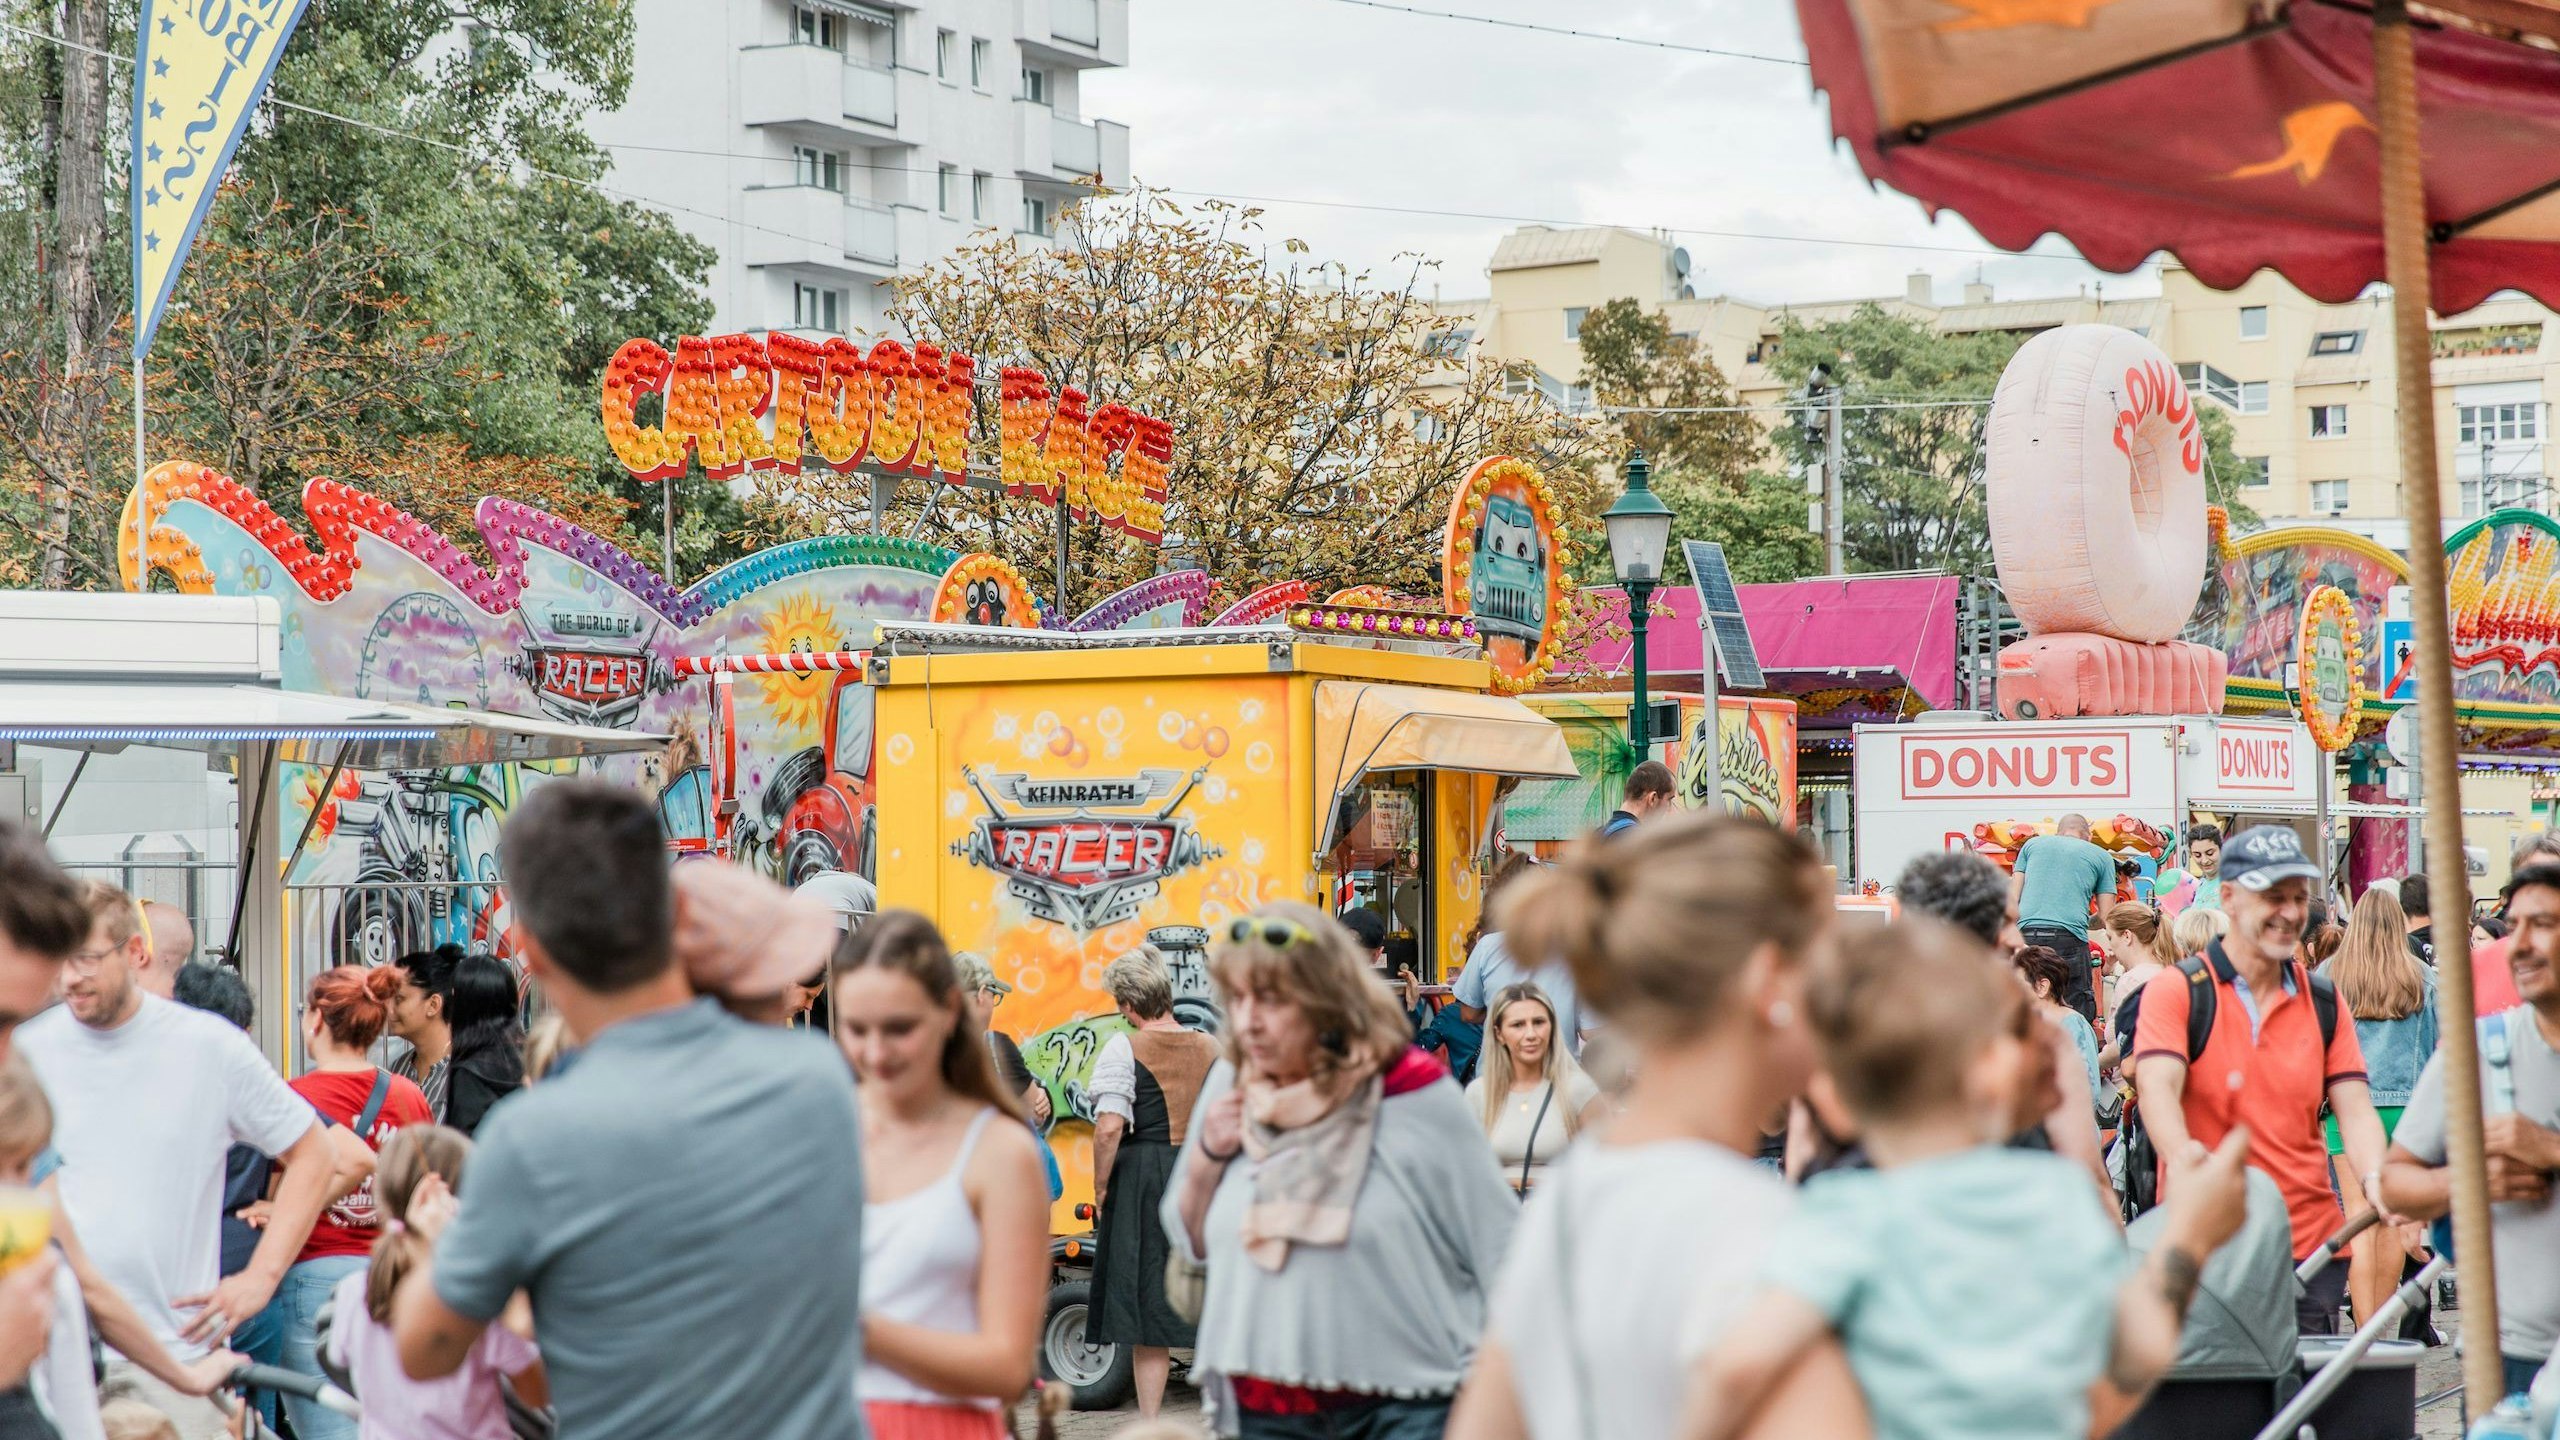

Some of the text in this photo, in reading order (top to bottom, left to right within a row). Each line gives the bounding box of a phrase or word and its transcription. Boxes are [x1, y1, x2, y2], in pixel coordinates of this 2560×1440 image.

[602, 330, 1174, 545] CARTOON RACE
[551, 613, 630, 633] THE WORLD OF
[544, 655, 642, 694] RACER
[1912, 745, 2117, 789] DONUTS
[2220, 737, 2290, 780] DONUTS
[1027, 784, 1135, 803] KEINRATH
[1002, 830, 1164, 874] RACER
